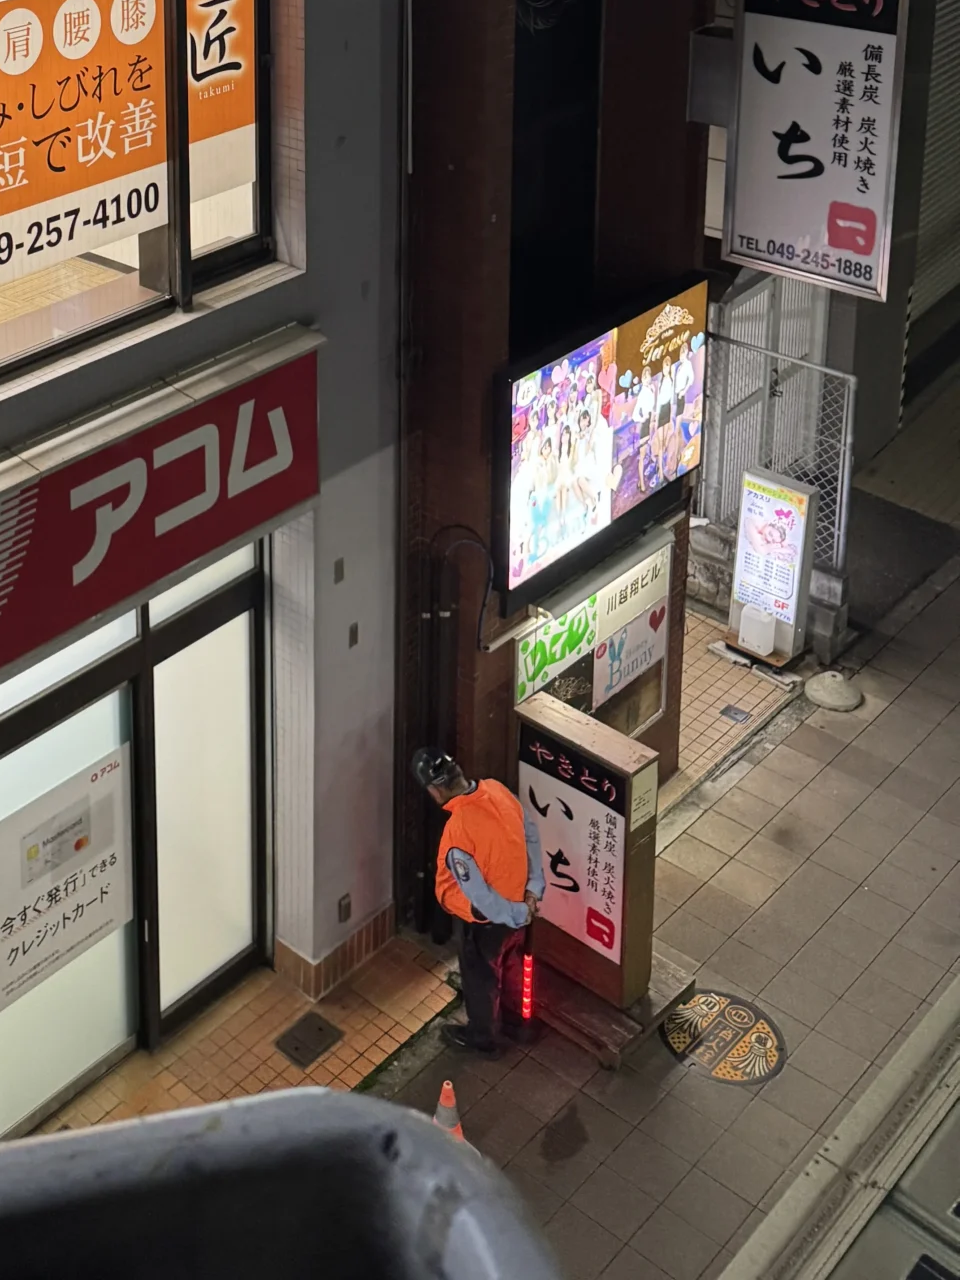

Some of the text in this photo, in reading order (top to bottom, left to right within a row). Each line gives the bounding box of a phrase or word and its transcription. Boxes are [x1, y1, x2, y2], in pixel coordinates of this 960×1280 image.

[3, 22, 32, 64] 肩
[63, 8, 91, 48] 腰
[199, 80, 235, 100] takumi
[753, 42, 825, 179] いち
[831, 61, 856, 168] 厳選素材使用
[854, 43, 883, 194] 備長炭 炭火焼き
[738, 234, 873, 282] TEL.049-245-1888
[70, 398, 294, 587] アコム
[100, 760, 120, 778] アコム
[529, 740, 617, 802] やきとり
[529, 785, 580, 893] いち
[587, 818, 601, 892] 厳選素材使用
[604, 812, 617, 857] 備長炭
[7, 882, 111, 967] クレジットカード
